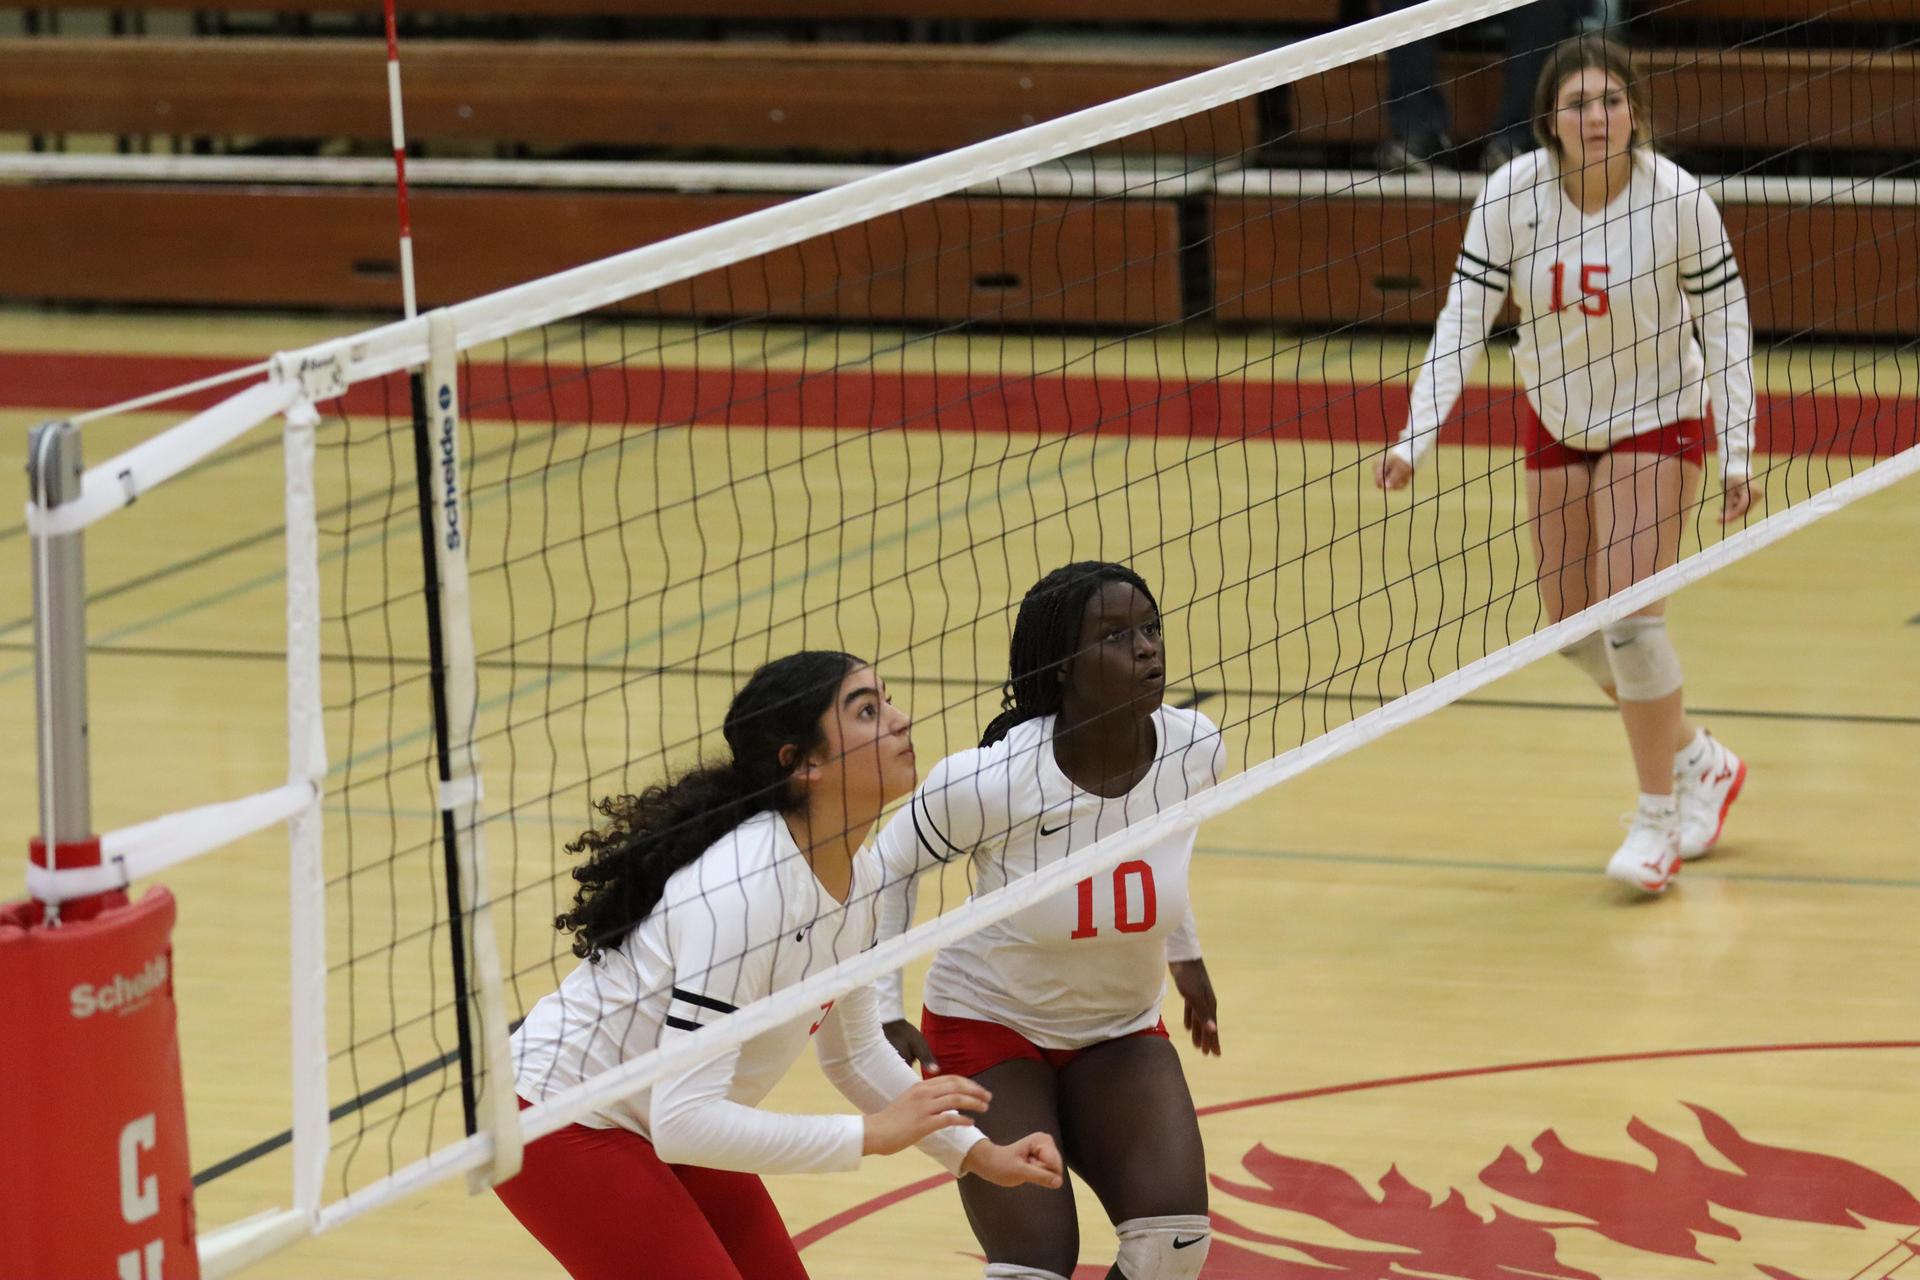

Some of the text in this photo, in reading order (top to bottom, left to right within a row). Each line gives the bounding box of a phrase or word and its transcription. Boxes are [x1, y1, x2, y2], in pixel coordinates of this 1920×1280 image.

[1548, 262, 1610, 317] 15
[440, 416, 460, 550] Schelde
[1071, 859, 1156, 940] 10
